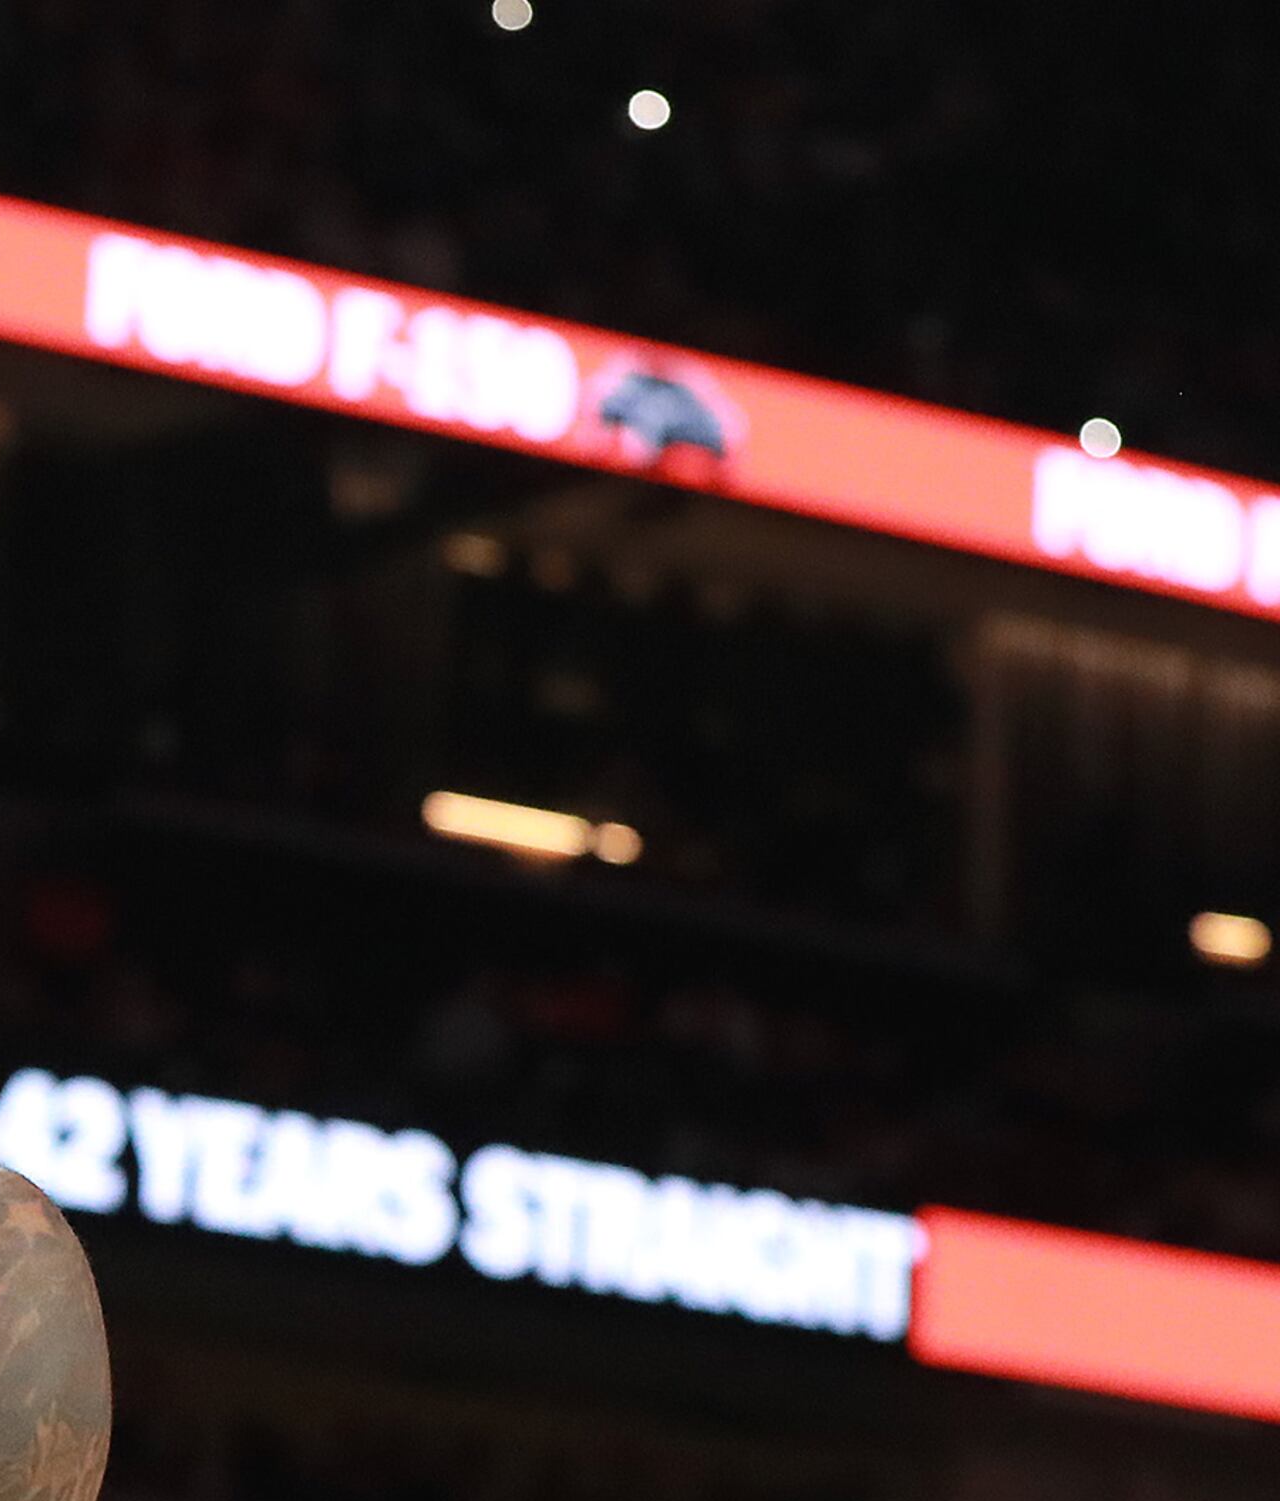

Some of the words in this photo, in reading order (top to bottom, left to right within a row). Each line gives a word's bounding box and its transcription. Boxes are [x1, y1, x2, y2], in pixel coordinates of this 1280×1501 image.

[84, 231, 328, 389] FORD
[328, 285, 580, 443] F-150
[126, 1082, 458, 1267] YEARS
[458, 1143, 927, 1344] STRAIGHT
